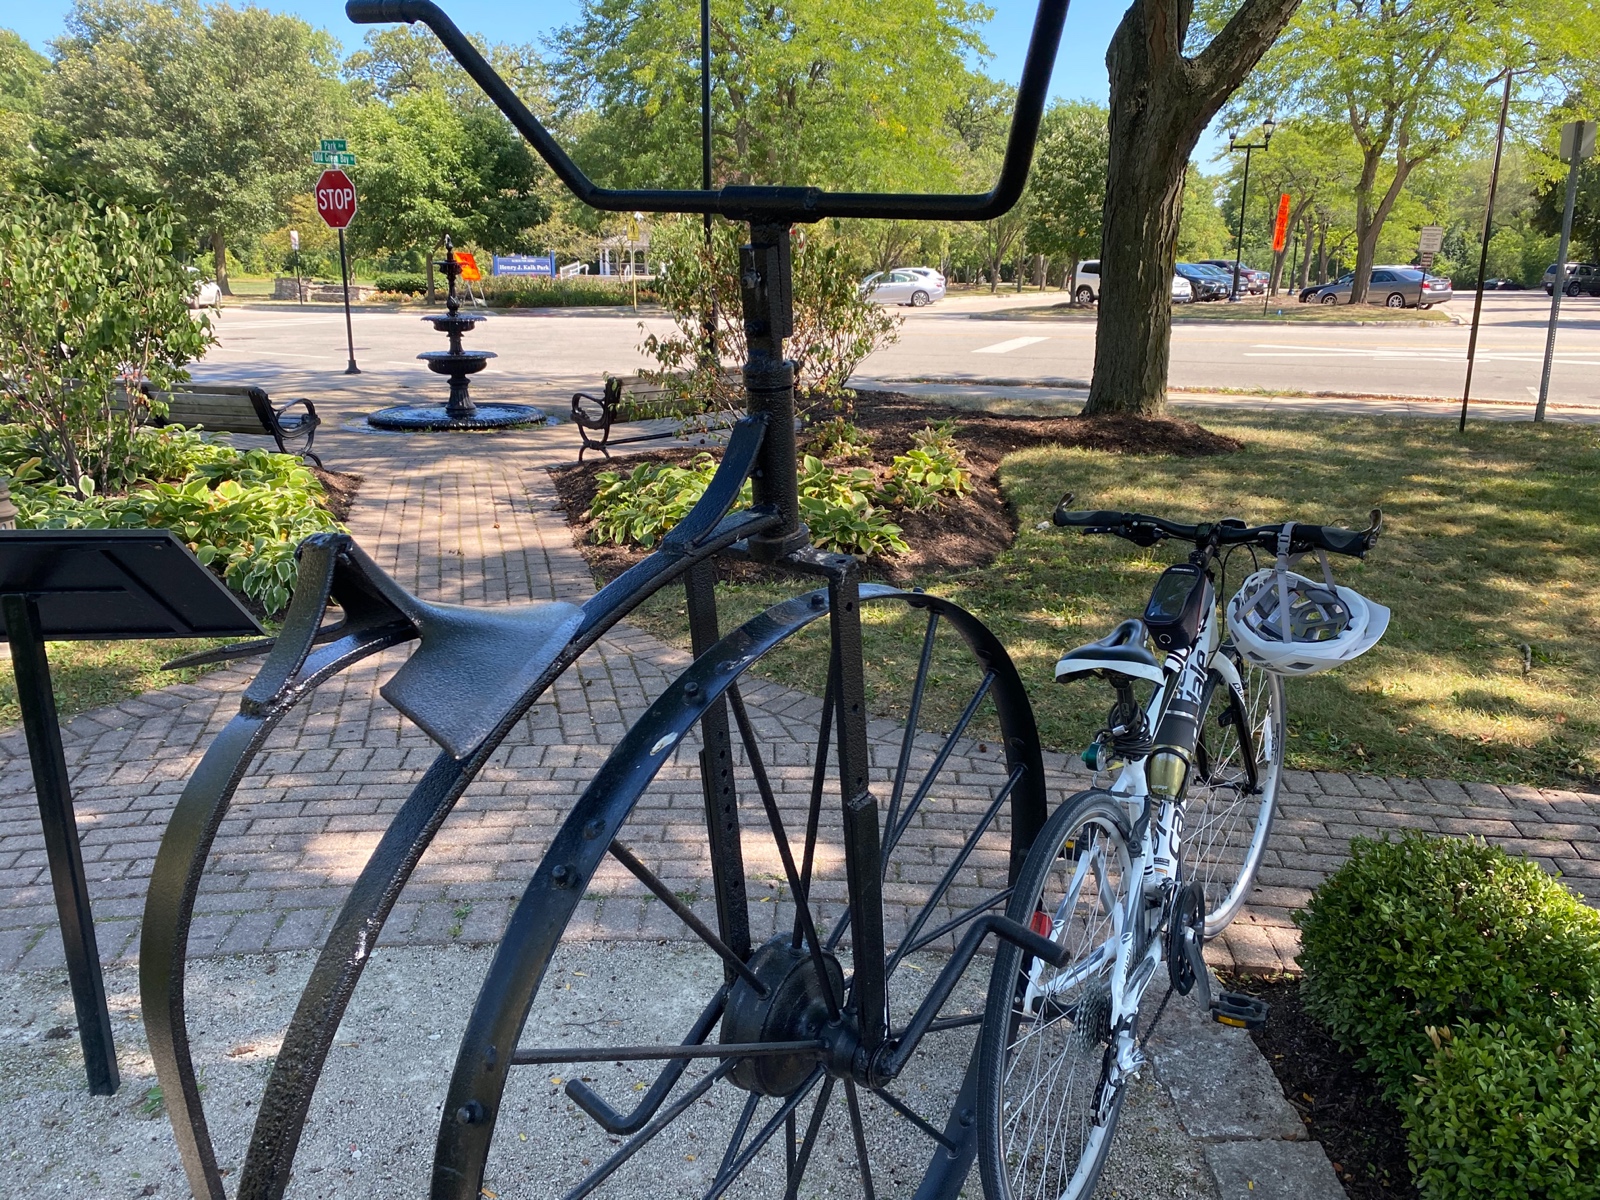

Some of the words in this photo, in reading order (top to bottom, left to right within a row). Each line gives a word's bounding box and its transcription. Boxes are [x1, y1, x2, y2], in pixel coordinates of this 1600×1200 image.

[324, 141, 337, 150] Park
[314, 152, 323, 161] Old
[340, 154, 349, 164] Bay
[319, 188, 352, 210] STOP
